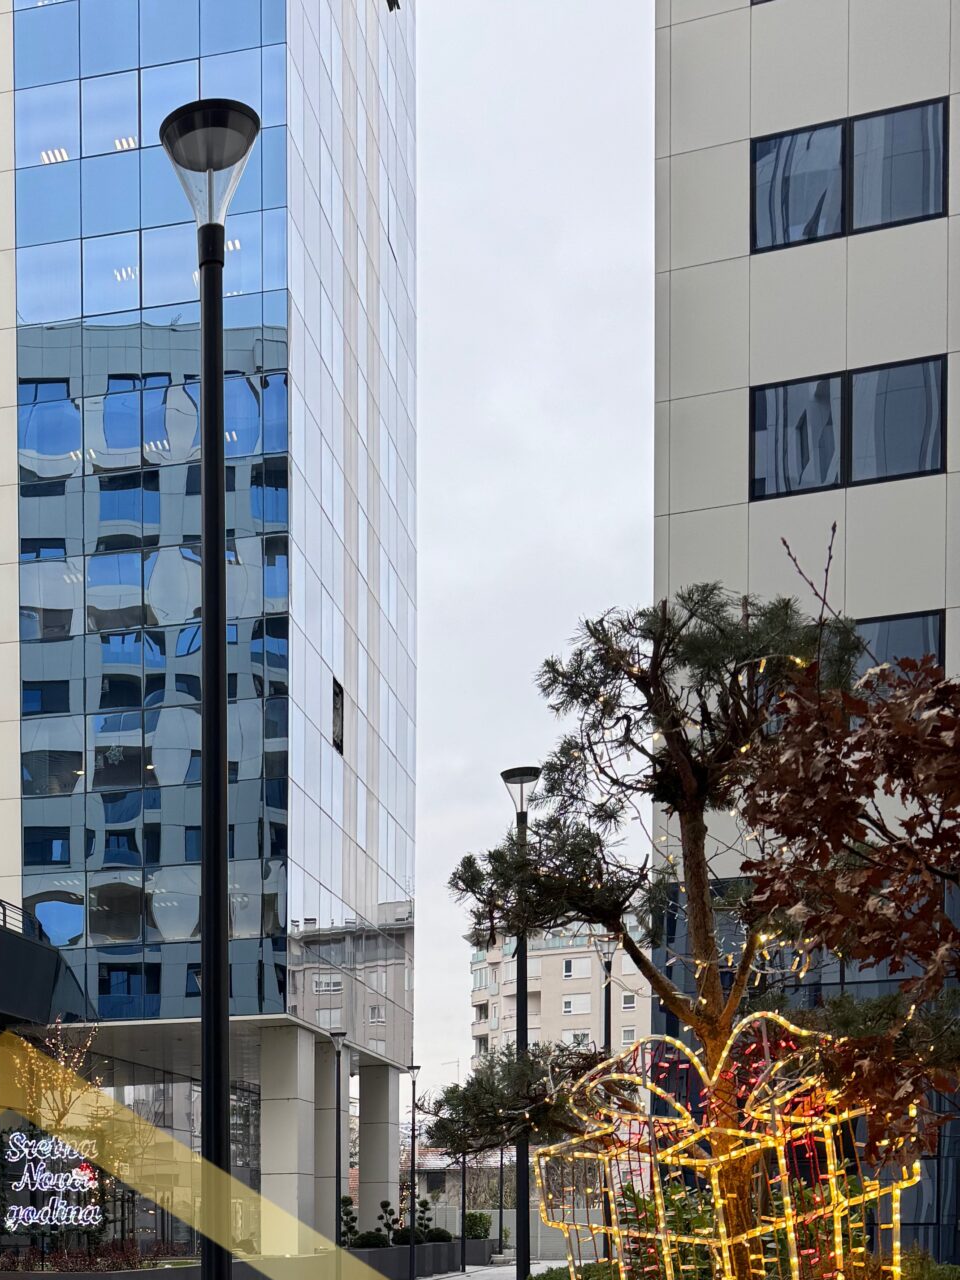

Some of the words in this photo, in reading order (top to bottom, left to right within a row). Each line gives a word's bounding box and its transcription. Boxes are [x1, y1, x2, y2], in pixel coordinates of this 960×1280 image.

[5, 1132, 99, 1162] Sretna
[12, 1161, 93, 1191] Nova
[5, 1196, 102, 1231] godina
